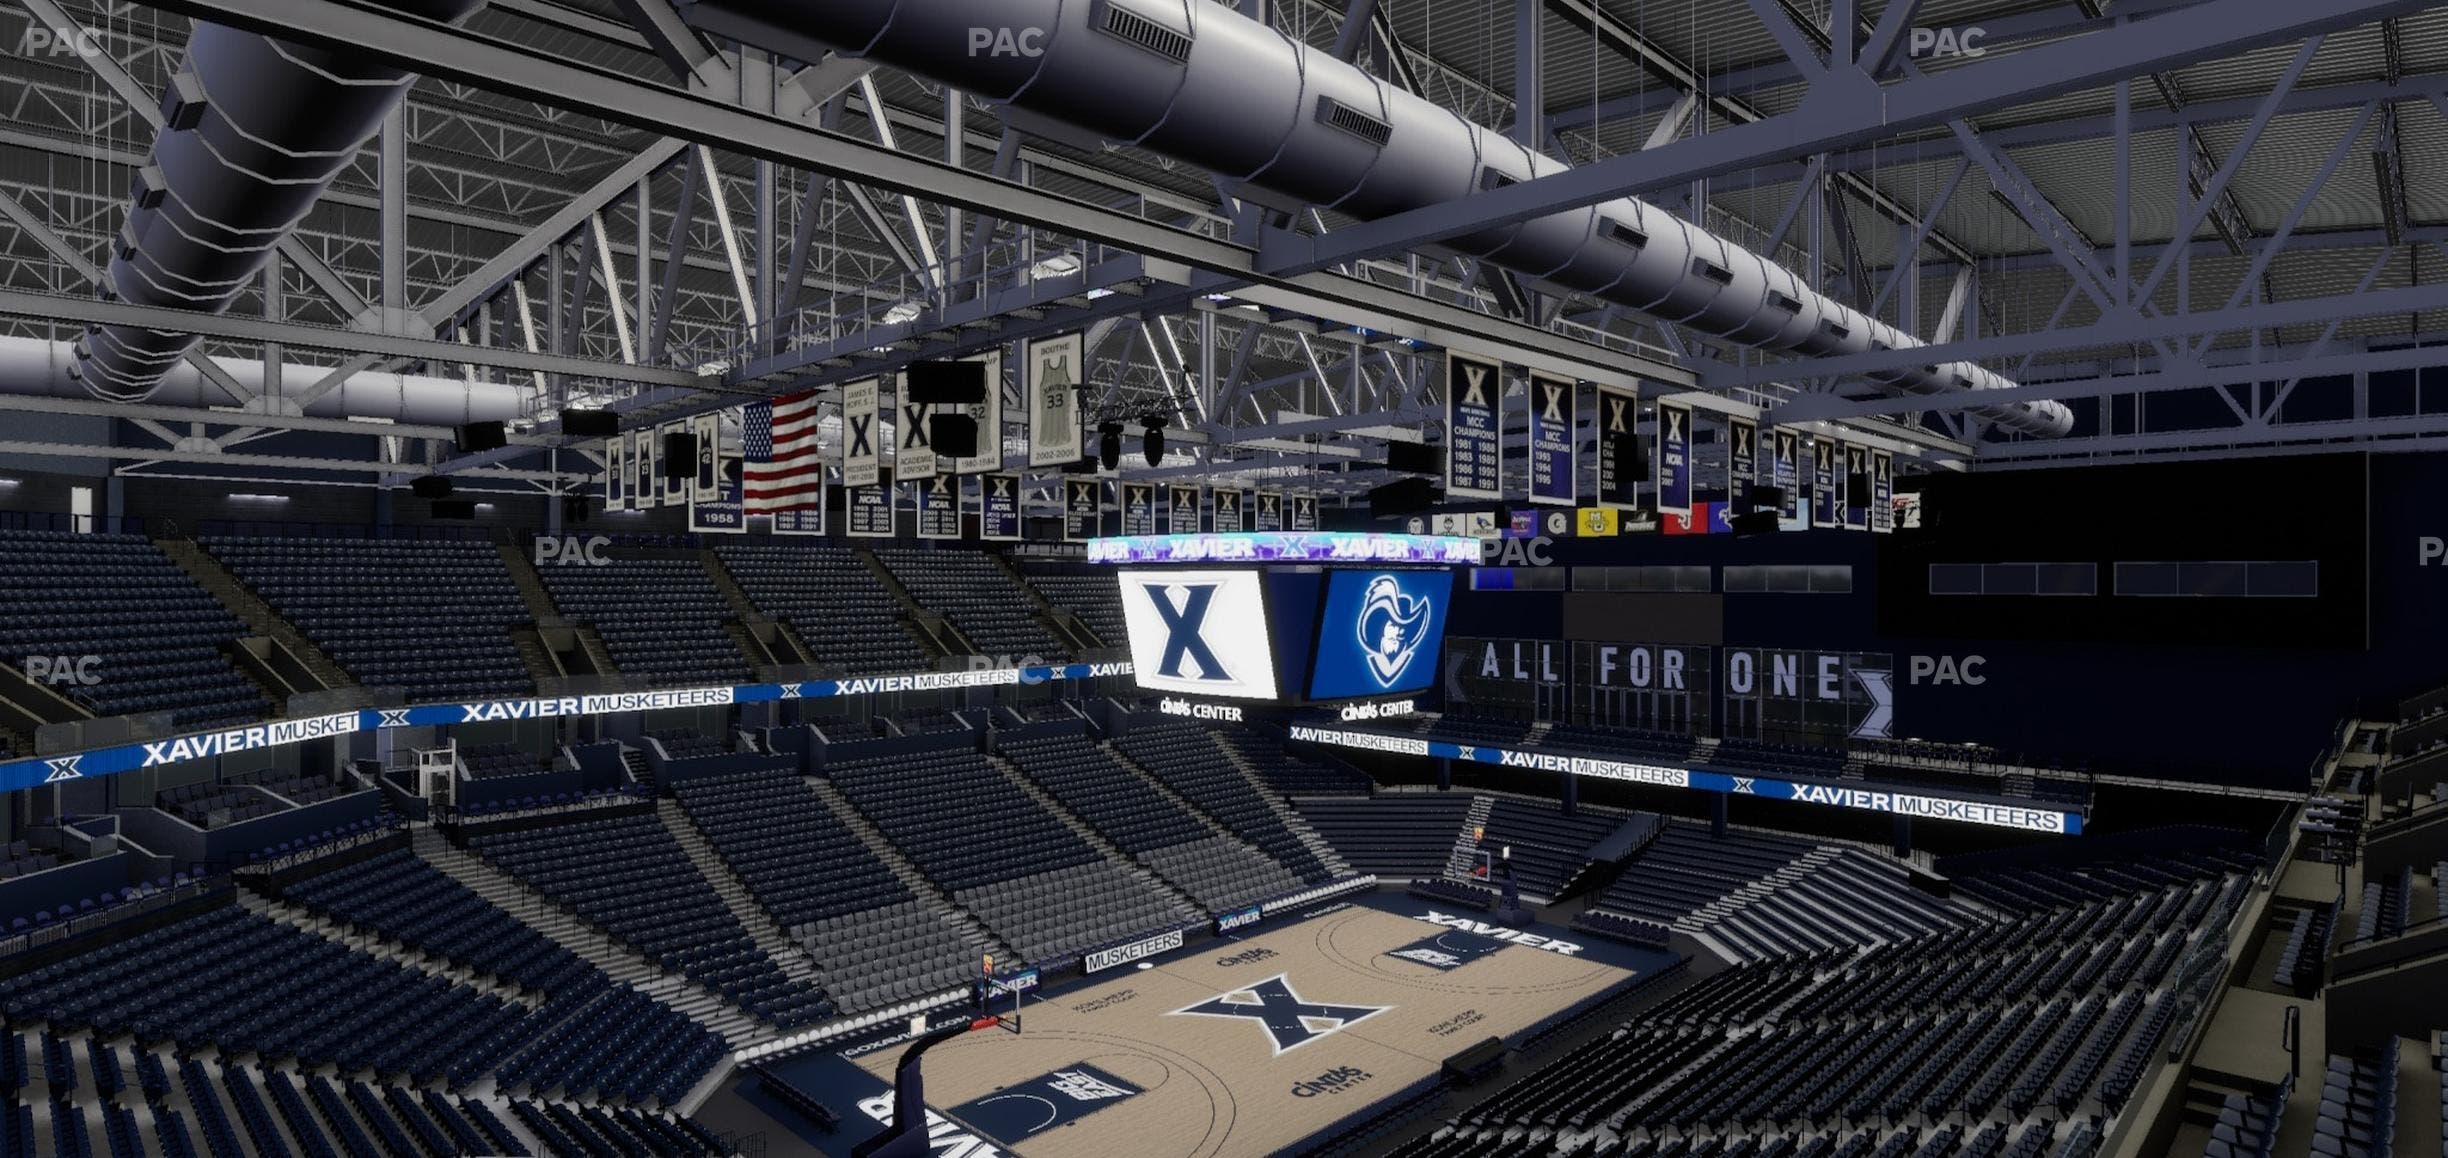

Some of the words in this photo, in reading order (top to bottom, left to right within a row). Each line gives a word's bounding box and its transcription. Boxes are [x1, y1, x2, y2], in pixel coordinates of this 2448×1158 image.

[1041, 342, 1070, 356] BOOTHE
[1462, 364, 1488, 407] X
[1047, 394, 1064, 409] 33
[971, 406, 985, 419] 32
[1466, 416, 1484, 428] MCC
[1454, 426, 1496, 440] CHAMPIONS
[1545, 431, 1560, 442] MCC
[1455, 439, 1472, 450] 1981
[1478, 442, 1496, 453] 1988
[1534, 440, 1570, 453] CHAMPIONS
[1455, 452, 1472, 462] 1983
[1478, 454, 1496, 465] 1989
[1455, 464, 1472, 474] 1986
[1478, 466, 1496, 477] 1990
[1535, 463, 1551, 473] 1994
[1455, 476, 1472, 487] 1987
[1478, 479, 1494, 490] 1991
[705, 513, 734, 523] 1958
[1169, 538, 1256, 560] XAVIER
[1330, 537, 1410, 560] XAVIER
[1481, 642, 1558, 682] ALL
[1601, 646, 1685, 689] FOR
[1730, 651, 1840, 700] ONE
[1193, 705, 1242, 722] CENTER
[1379, 700, 1414, 718] CENTER
[142, 728, 268, 768] XAVIER
[274, 713, 359, 743] MUSKET
[461, 698, 580, 723] XAVIER
[588, 688, 731, 713] MUSKETEERS
[834, 676, 913, 695] XAVIER
[918, 669, 1015, 689] MUSKETEERS
[1290, 726, 1342, 745] XAVIER
[1346, 732, 1425, 754] MUSKETEERS
[1500, 750, 1570, 772] XAVIER
[1576, 758, 1685, 785] MUSKETEERS
[1790, 783, 1891, 812] XAVIER
[1899, 797, 2059, 830] MUSKETEERS
[1219, 911, 1260, 932] XAVIER
[1412, 910, 1585, 956] XAVIER
[1088, 932, 1181, 971] MUSKETEERS
